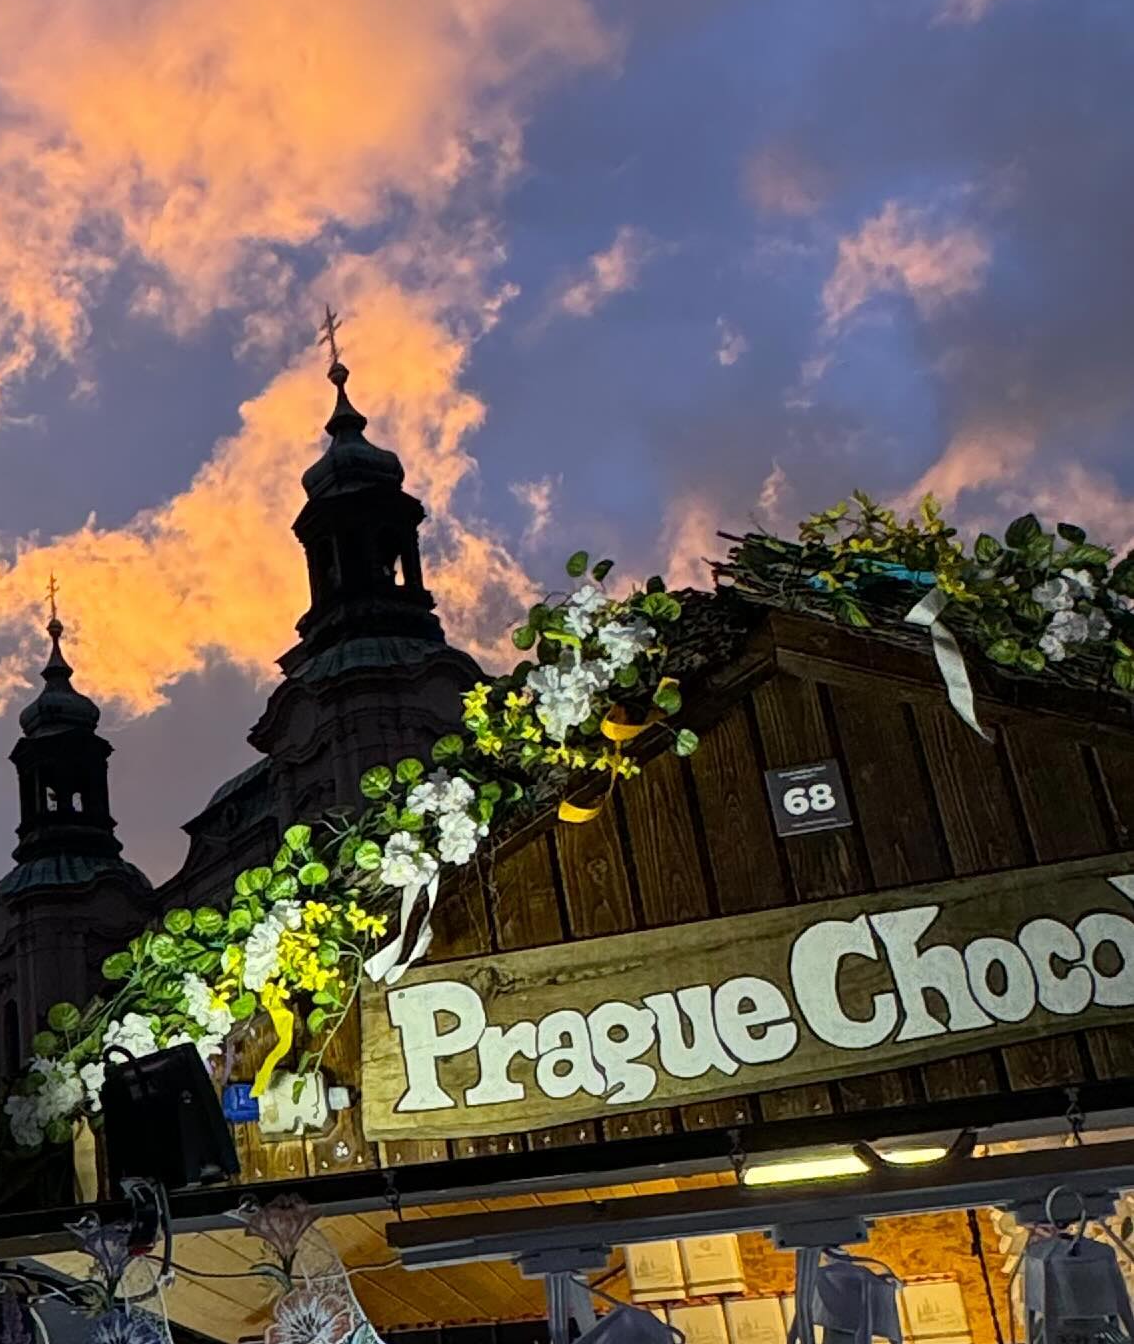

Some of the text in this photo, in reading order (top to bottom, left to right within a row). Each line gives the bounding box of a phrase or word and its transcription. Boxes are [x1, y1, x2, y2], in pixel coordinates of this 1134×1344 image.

[783, 783, 836, 816] 68
[387, 874, 1134, 1114] Prague Choco
